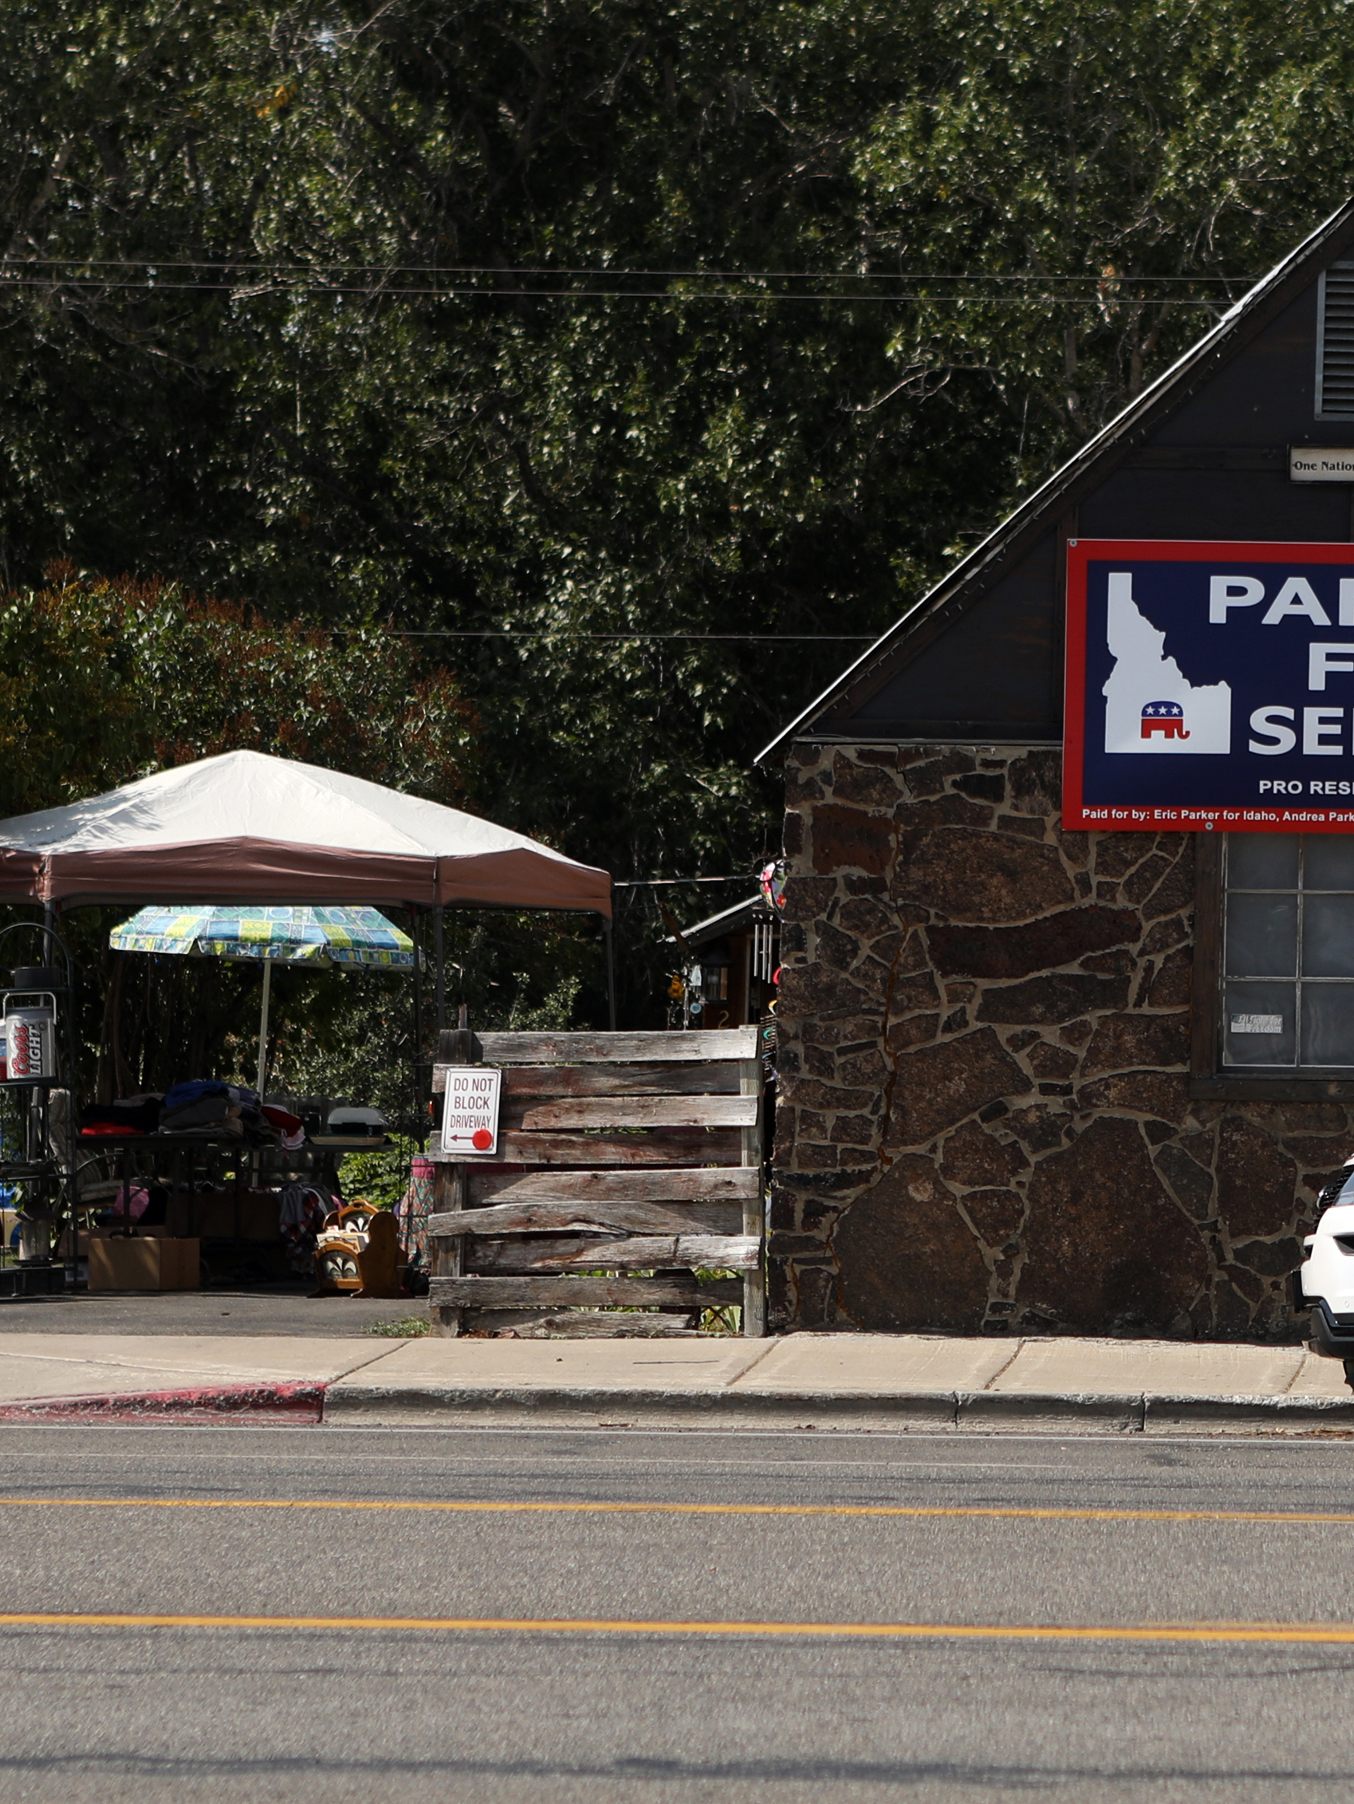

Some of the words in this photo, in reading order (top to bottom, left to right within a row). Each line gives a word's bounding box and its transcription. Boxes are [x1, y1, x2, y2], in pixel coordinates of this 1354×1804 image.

[1258, 780, 1303, 795] PRO
[1082, 808, 1108, 819] Paid
[1111, 809, 1128, 819] for
[1131, 809, 1150, 821] by:
[1154, 809, 1178, 820] Eric
[1181, 809, 1220, 820] Parker
[1223, 810, 1240, 820] for
[1243, 811, 1280, 822] Idaho,
[1282, 811, 1325, 822] Andrea
[13, 1025, 29, 1075] Coors
[29, 1025, 41, 1075] LIGHT
[454, 1078, 469, 1091] DO
[471, 1078, 494, 1092] NOT
[454, 1096, 490, 1110] BLOCK
[450, 1114, 492, 1128] DRIVEWAY
